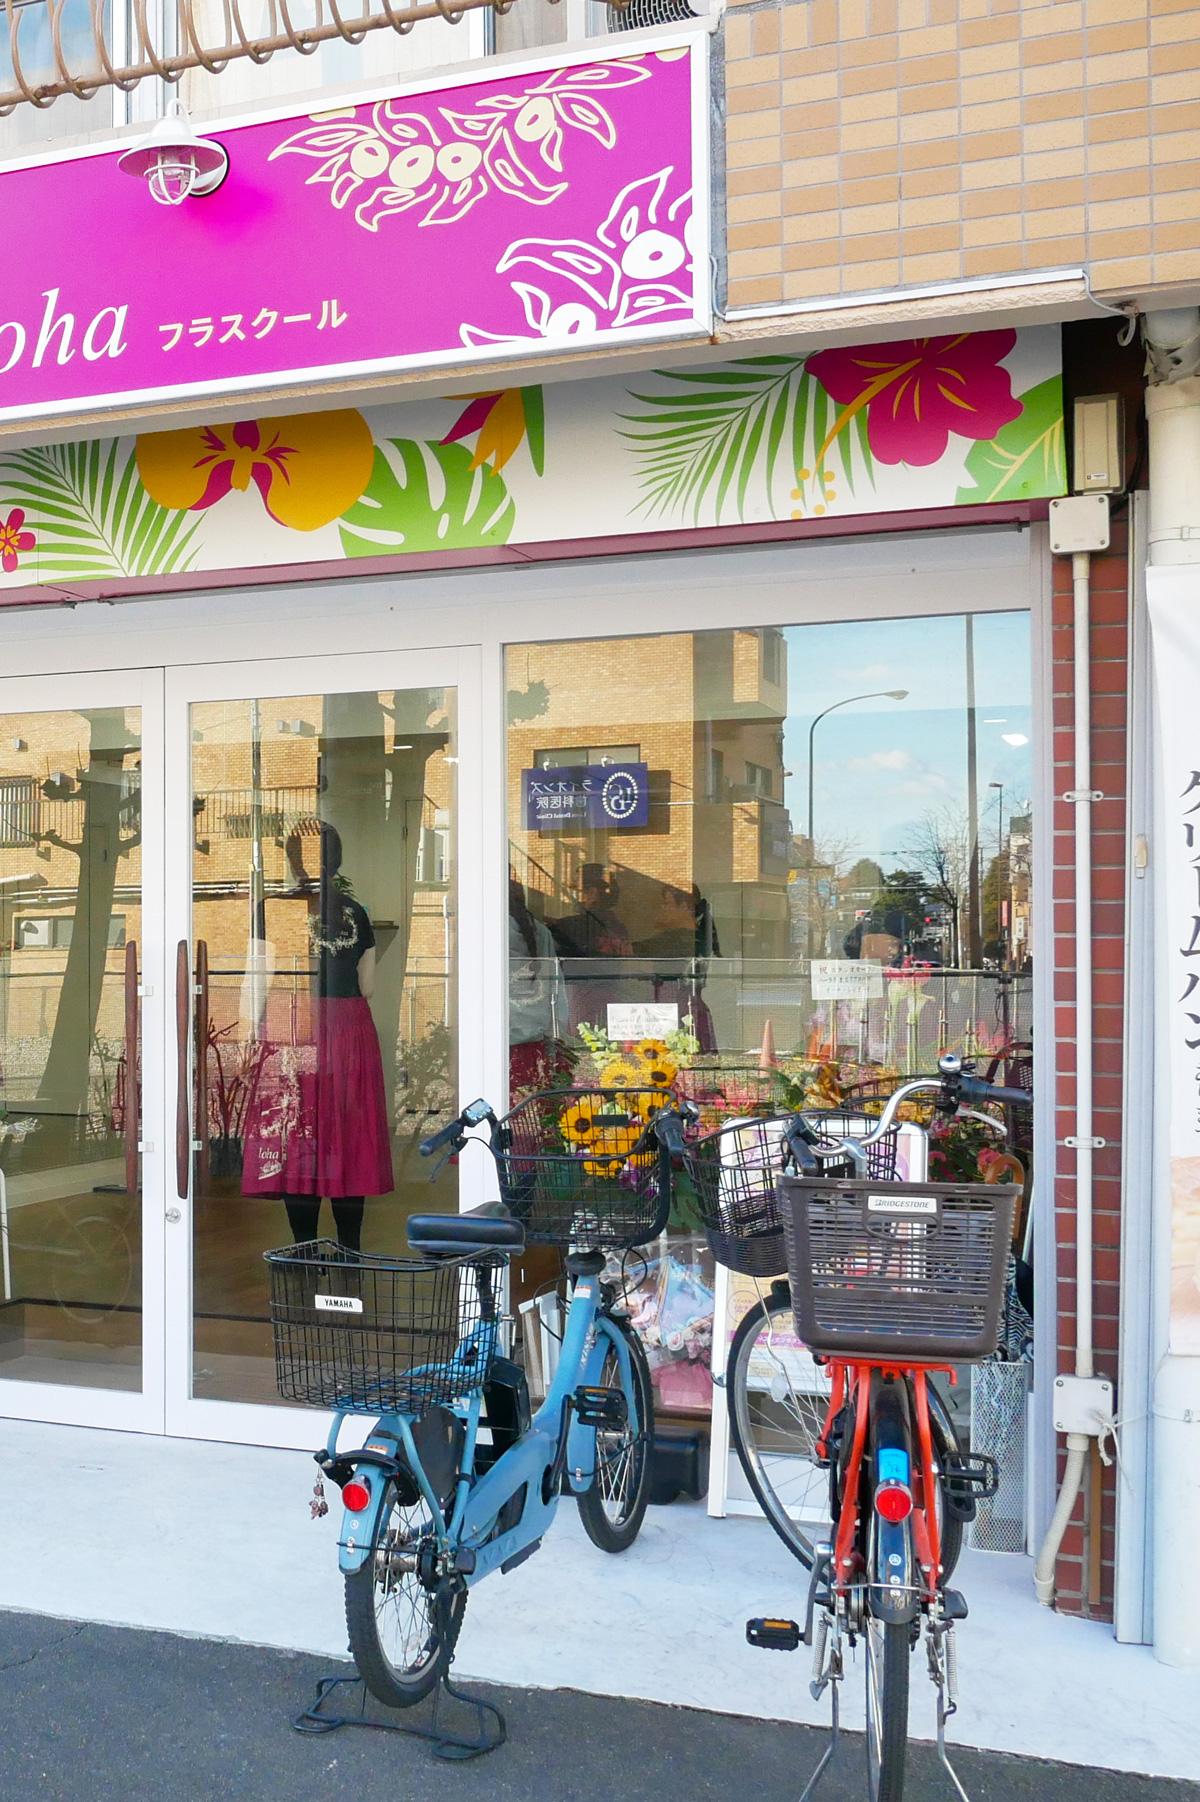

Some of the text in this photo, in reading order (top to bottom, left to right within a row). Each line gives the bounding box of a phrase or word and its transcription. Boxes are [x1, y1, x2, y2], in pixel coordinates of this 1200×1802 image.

[158, 298, 348, 352] フラスクール
[874, 1198, 930, 1209] BRIDGESTONE
[324, 1298, 354, 1309] YAMAHA
